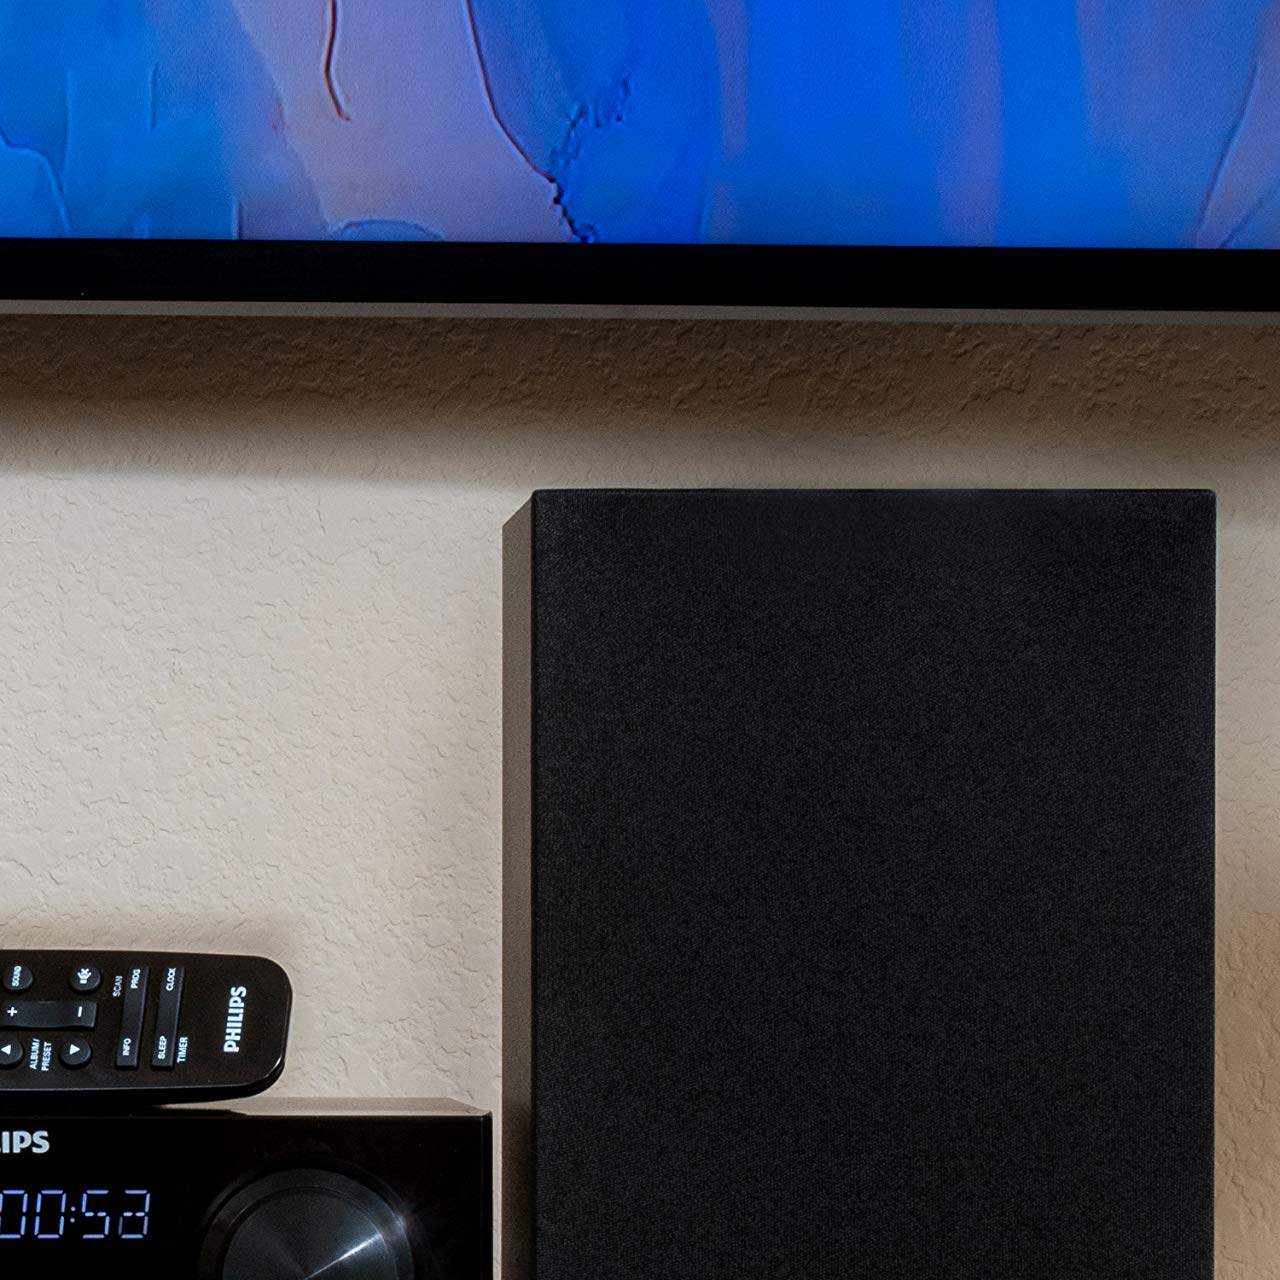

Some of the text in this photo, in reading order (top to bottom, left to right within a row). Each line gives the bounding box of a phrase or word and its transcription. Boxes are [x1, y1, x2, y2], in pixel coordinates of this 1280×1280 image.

[11, 965, 22, 987] SOUND
[112, 975, 123, 997] SCAN
[130, 968, 141, 989] PROG
[165, 967, 177, 992] CLOCK
[223, 986, 247, 1053] PHILIPS
[40, 1041, 52, 1072] PRESET
[122, 1037, 132, 1056] INFO
[157, 1035, 167, 1060] SLEEP
[176, 1036, 189, 1063] TIMER
